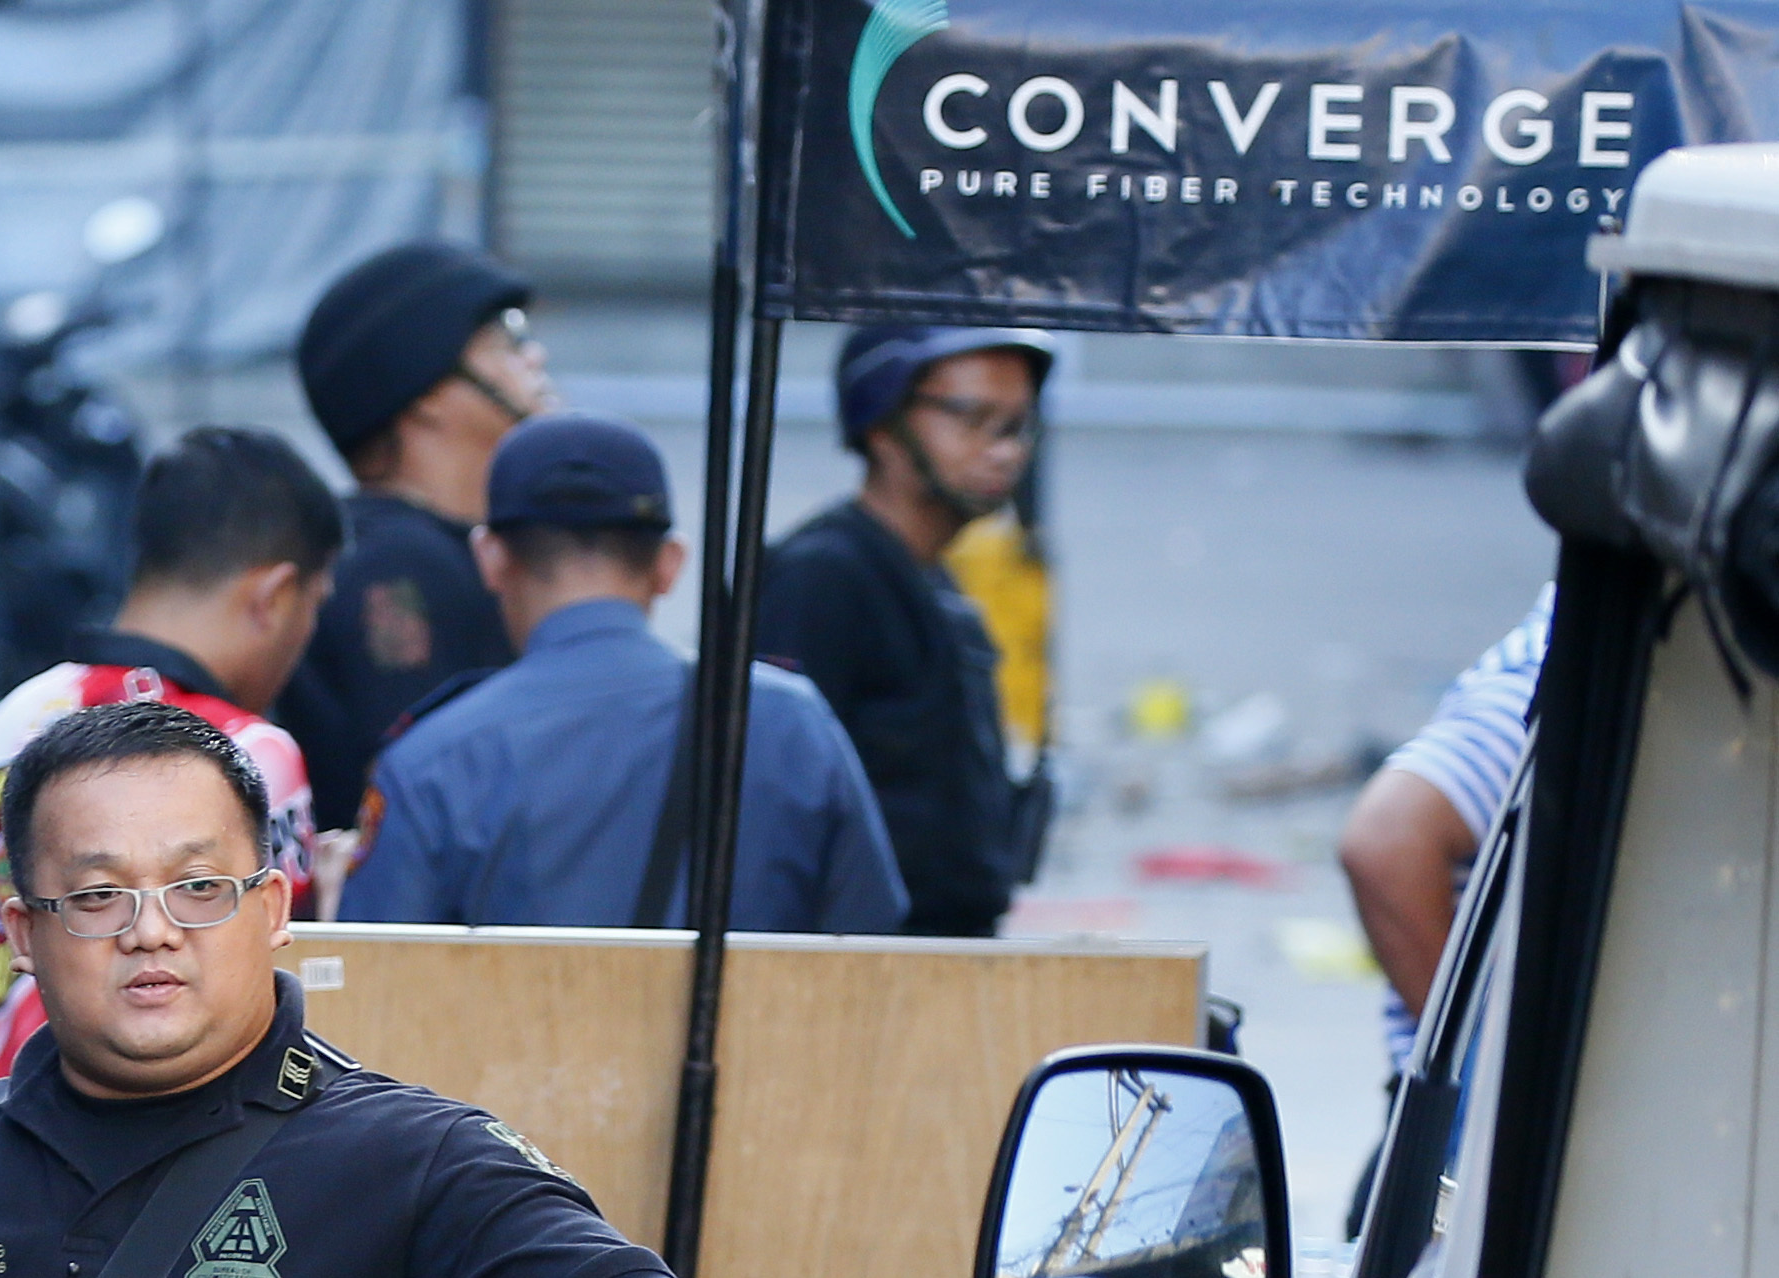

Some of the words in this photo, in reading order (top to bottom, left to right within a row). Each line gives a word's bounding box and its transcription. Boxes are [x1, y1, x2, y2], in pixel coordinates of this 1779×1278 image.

[922, 72, 1635, 168] CONVERGE
[920, 168, 1051, 199] PURE
[1086, 173, 1239, 205] FIBER
[1275, 179, 1624, 214] TECHNOLOGY
